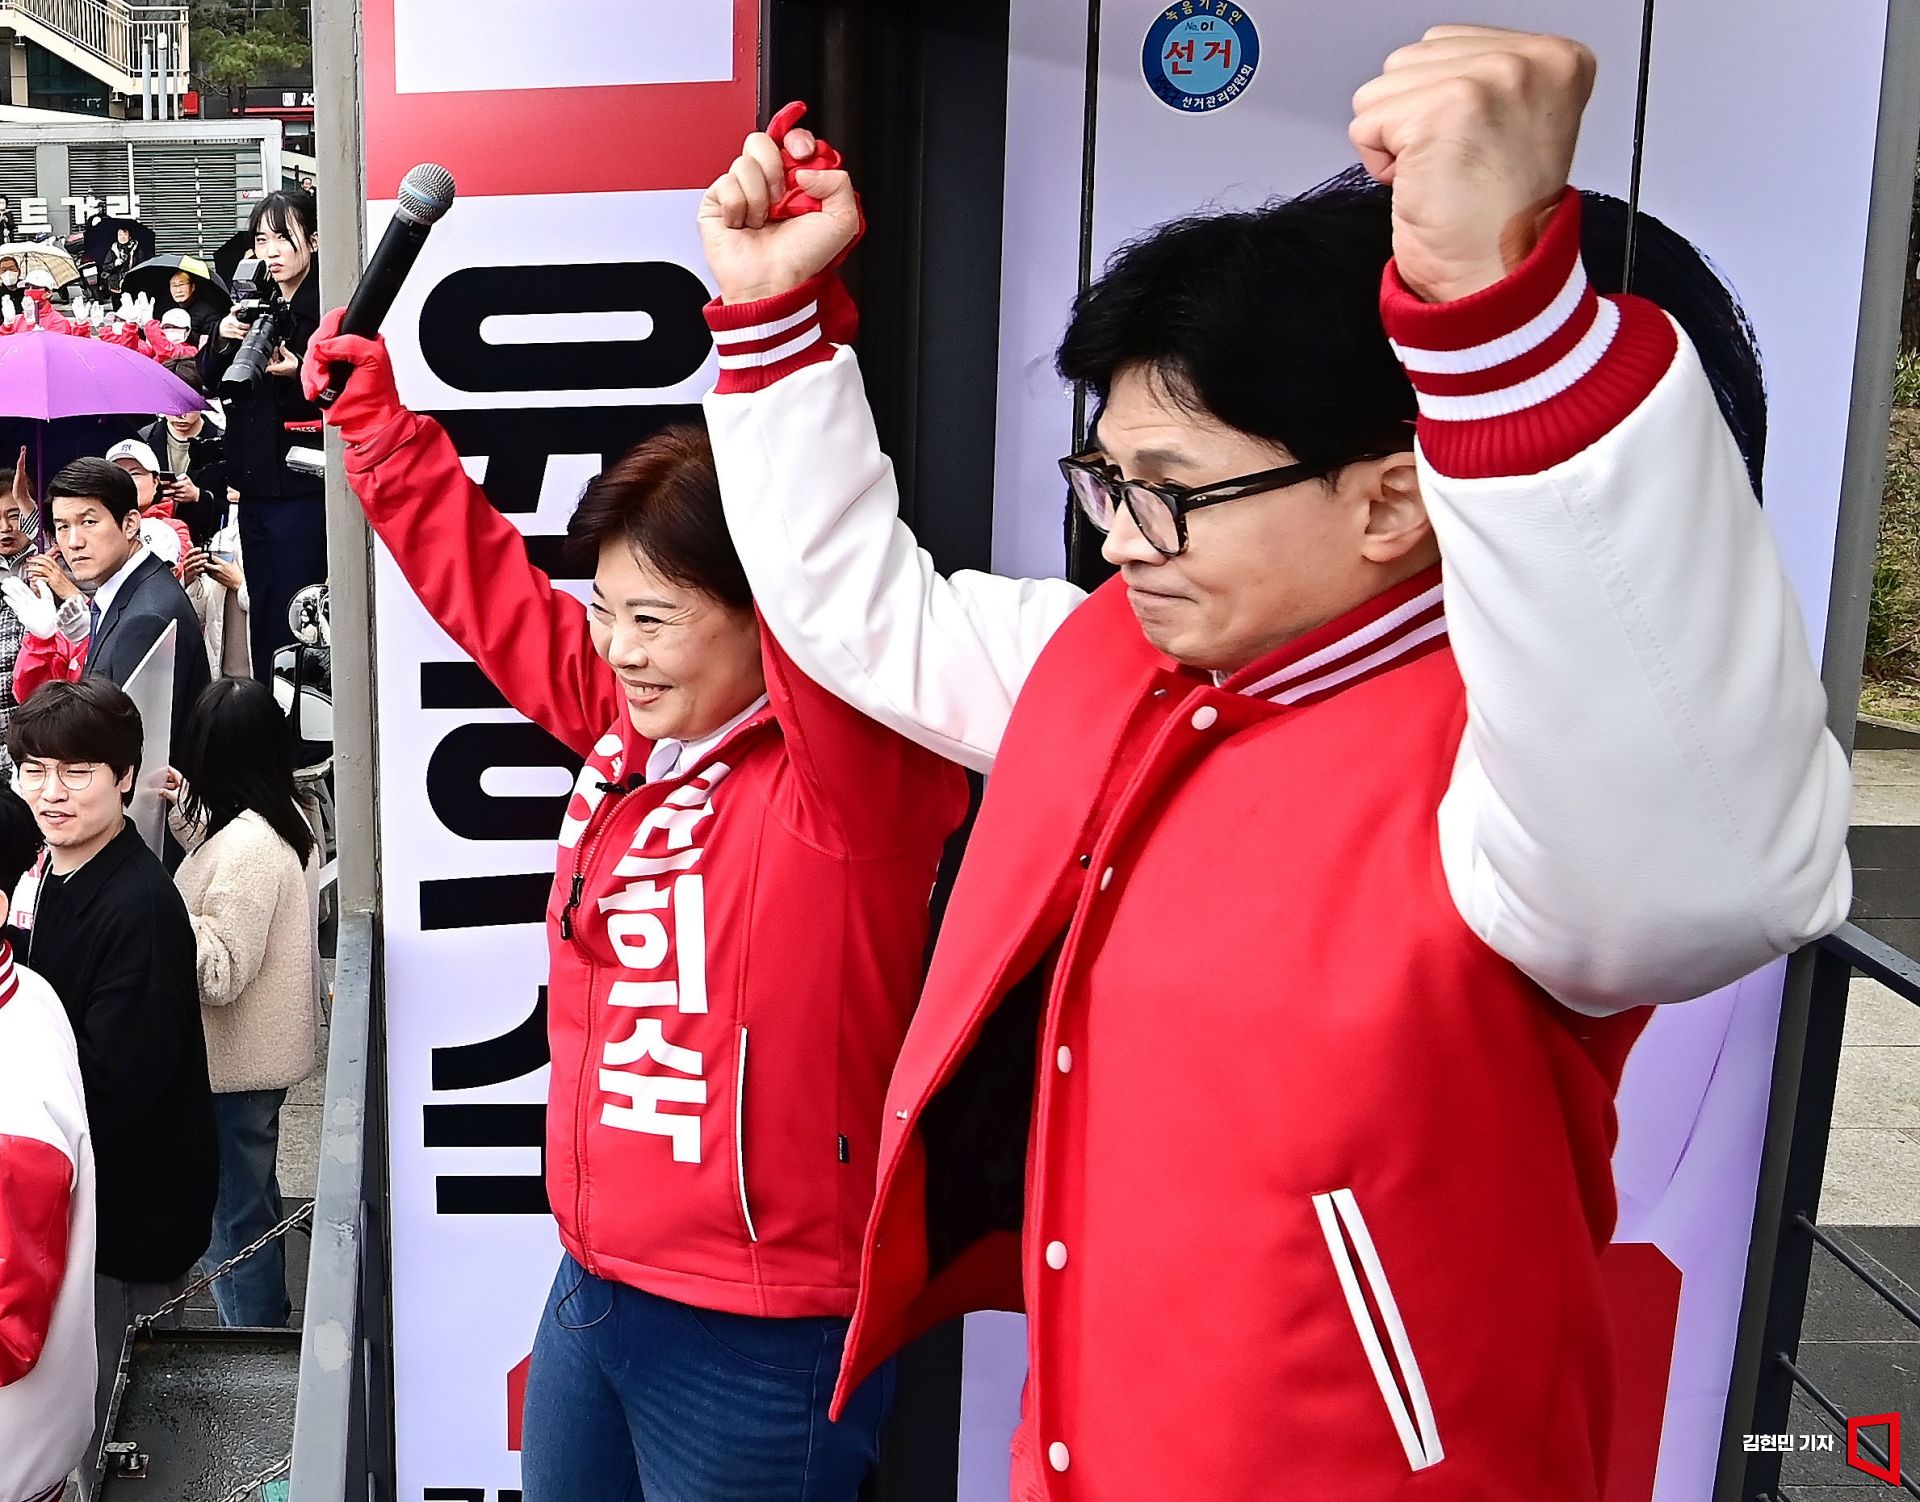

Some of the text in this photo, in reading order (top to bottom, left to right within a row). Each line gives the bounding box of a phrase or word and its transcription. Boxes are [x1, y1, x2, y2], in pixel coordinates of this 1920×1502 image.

[1163, 38, 1232, 75] 선거
[1182, 64, 1254, 109] 선거관리위원회
[597, 761, 732, 1164] 윤희숙
